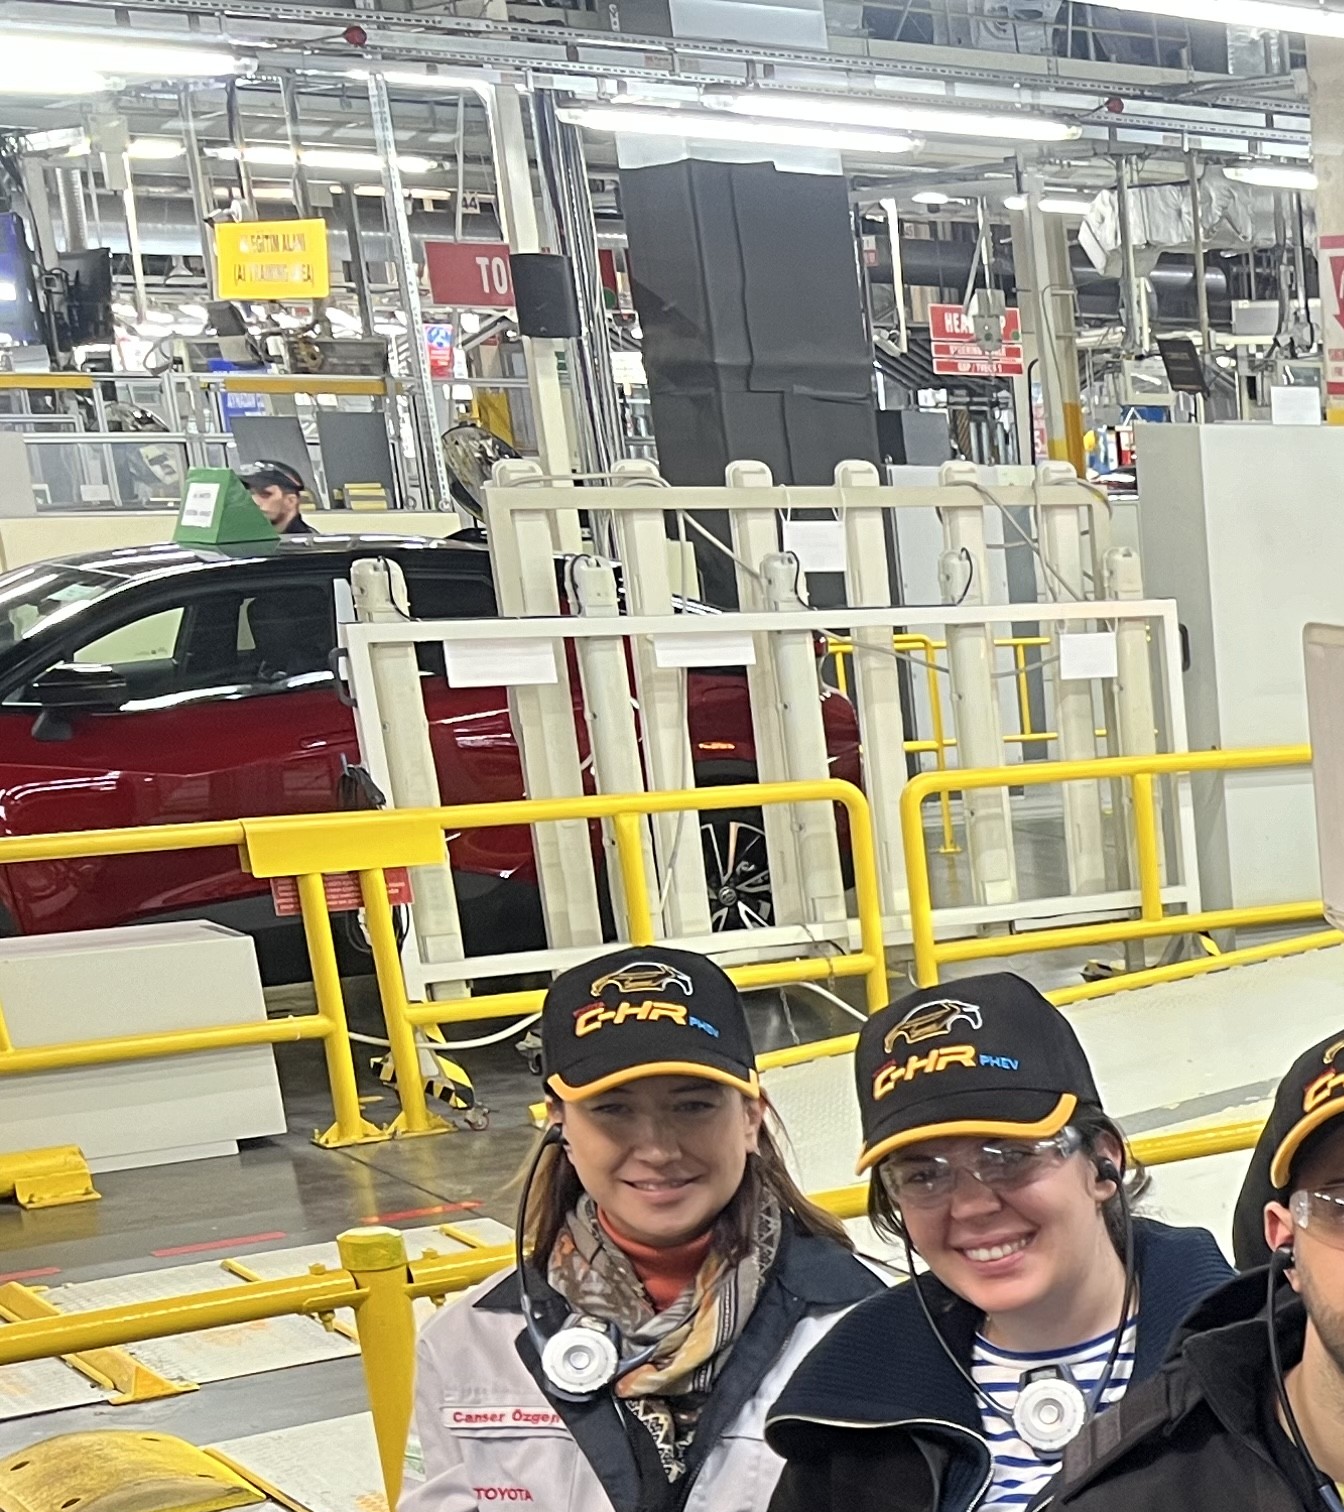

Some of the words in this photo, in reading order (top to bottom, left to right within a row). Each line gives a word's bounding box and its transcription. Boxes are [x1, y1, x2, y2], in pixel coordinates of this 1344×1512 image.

[575, 1000, 688, 1038] C-HR
[873, 1044, 977, 1101] C-HR
[979, 1053, 1019, 1071] PHEV
[453, 1411, 506, 1423] Canser
[511, 1408, 560, 1425] Özgen
[472, 1487, 534, 1502] TOYOTA
